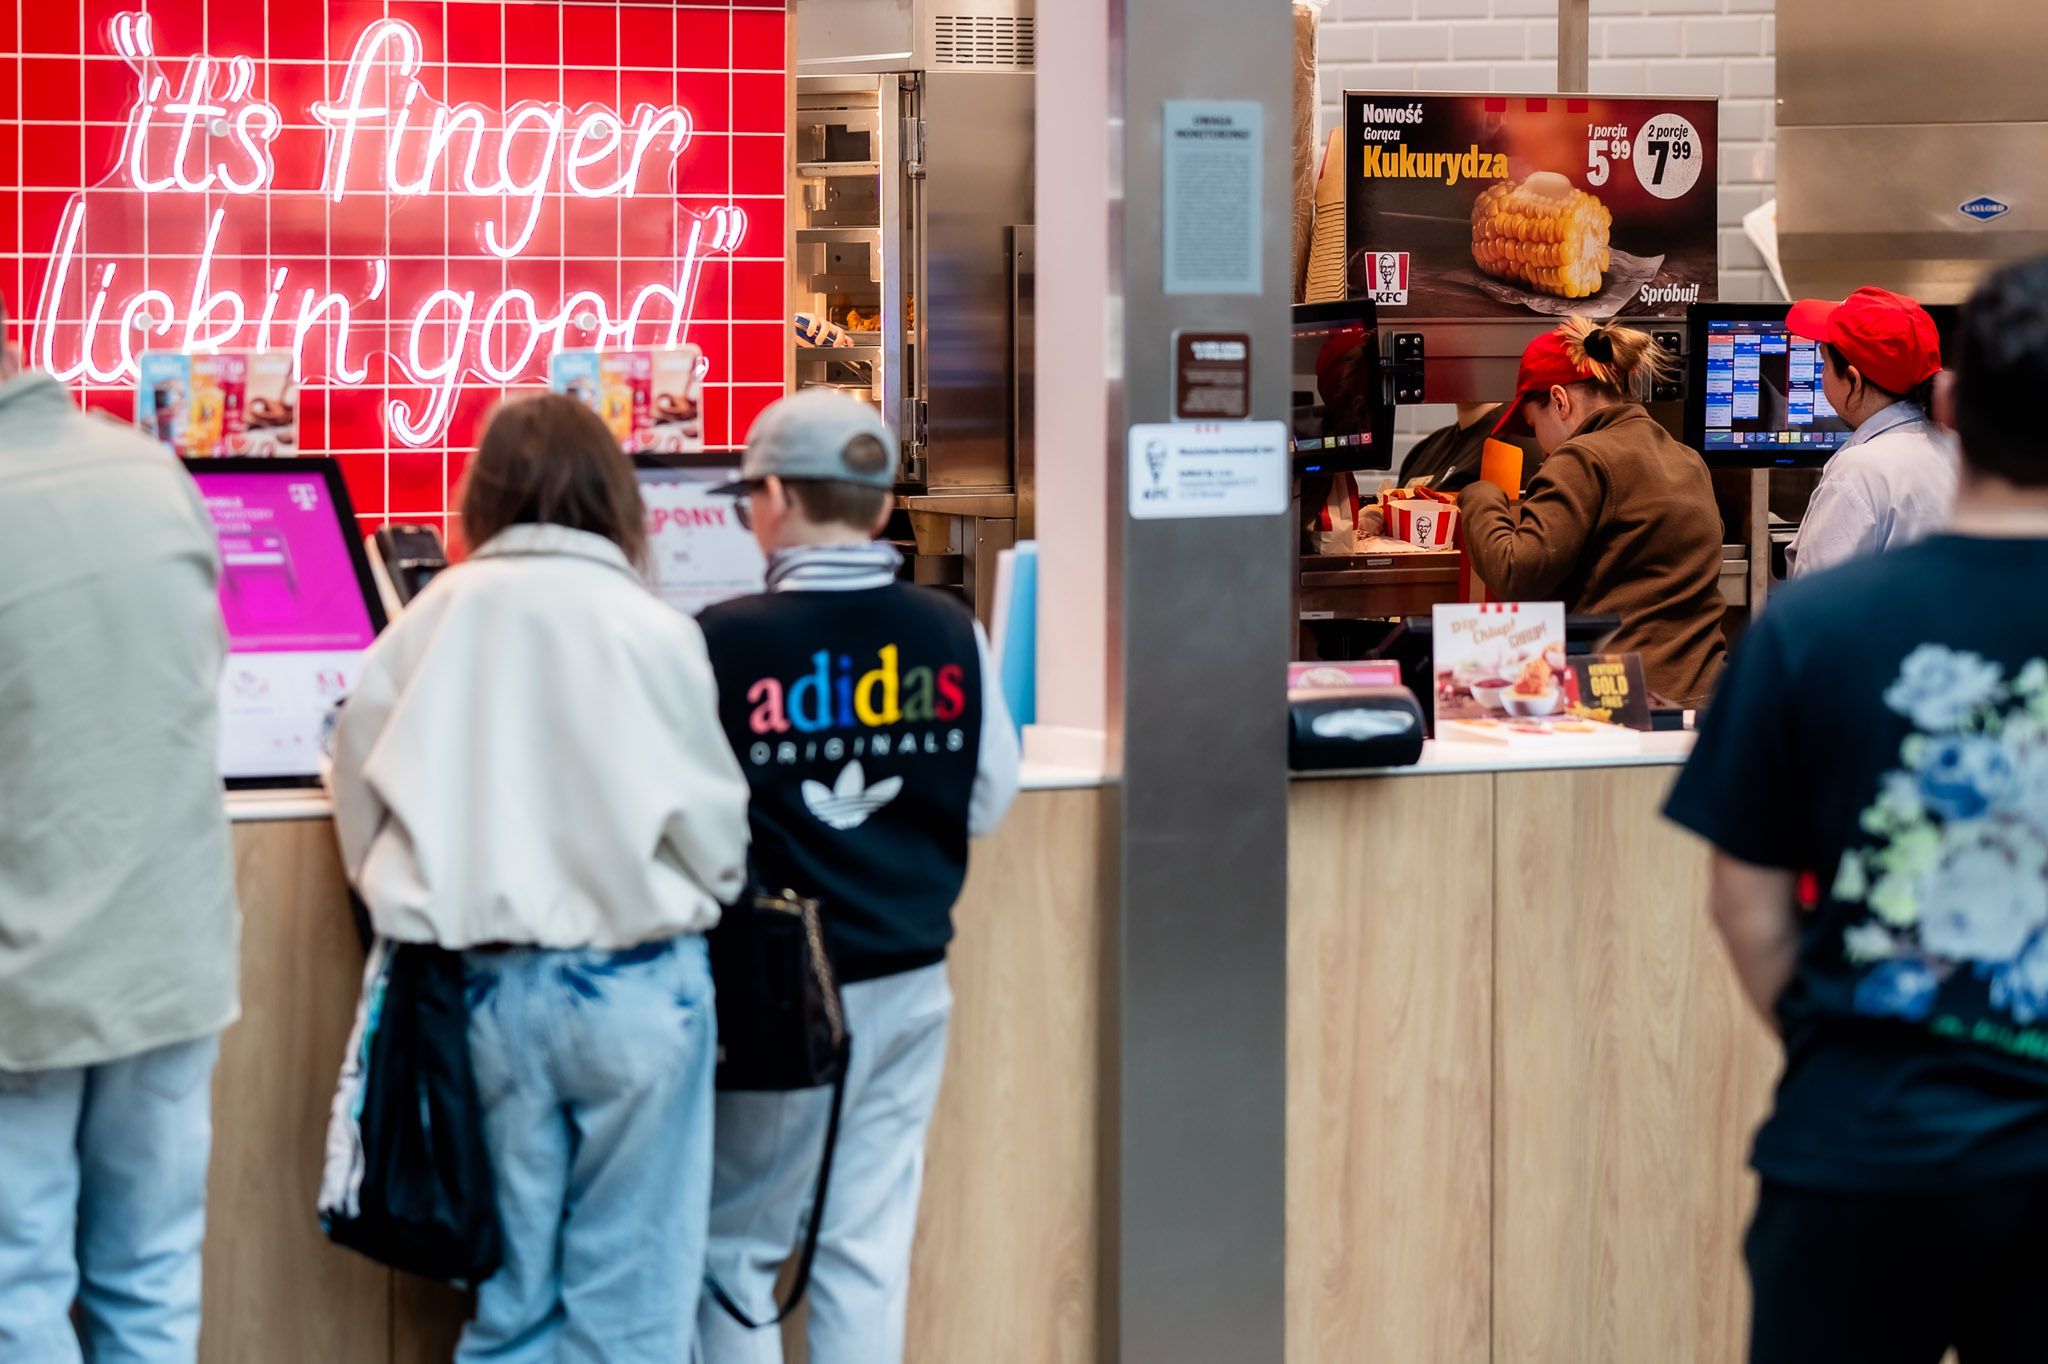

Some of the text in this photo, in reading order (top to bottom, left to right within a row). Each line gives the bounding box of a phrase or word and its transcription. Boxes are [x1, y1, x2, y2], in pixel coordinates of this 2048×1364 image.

[1363, 103, 1424, 124] Nowość
[318, 23, 690, 258] finger
[1364, 126, 1401, 143] Gorąca
[1587, 123, 1628, 140] 1 porcja
[1647, 124, 1689, 140] 2 porcje
[1363, 143, 1509, 186] Kukurydza
[1963, 204, 2006, 213] GAYLORD
[1375, 291, 1402, 303] KFC
[1640, 283, 1700, 306] Spróbuj!
[747, 643, 966, 735] adidas
[1590, 675, 1630, 697] GOLD
[749, 728, 965, 766] ORIGINALS
